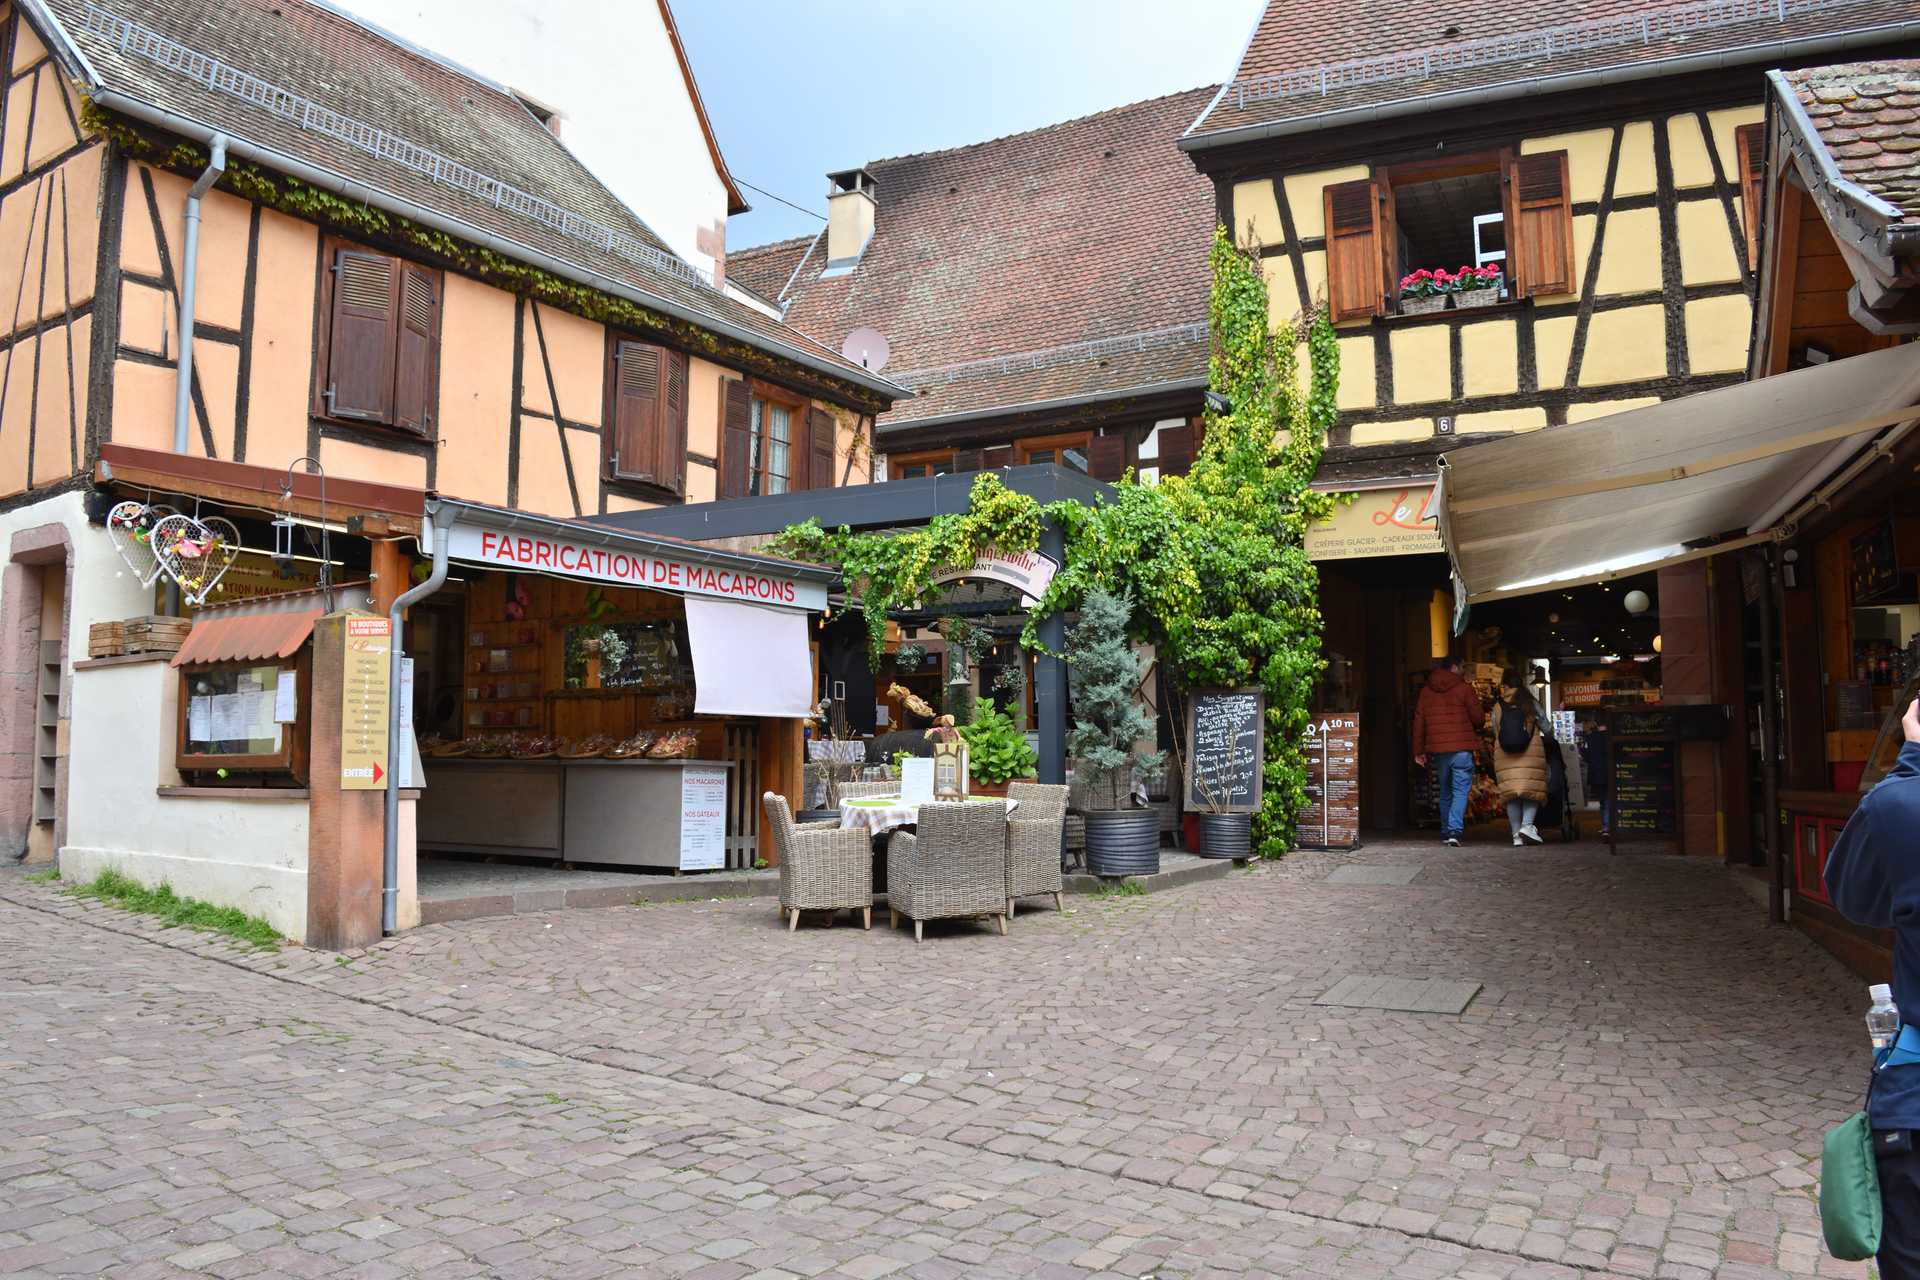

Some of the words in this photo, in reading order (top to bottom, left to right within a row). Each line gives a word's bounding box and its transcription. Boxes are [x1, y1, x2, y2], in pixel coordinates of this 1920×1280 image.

[1440, 419, 1448, 431] 6
[1347, 537, 1376, 546] GLACIER
[1416, 533, 1439, 541] SOUVE
[481, 532, 646, 582] FABRICATION
[652, 559, 681, 586] DE
[686, 566, 795, 602] MACARONS
[1564, 684, 1600, 695] SAVONNE
[1331, 719, 1342, 728] 10
